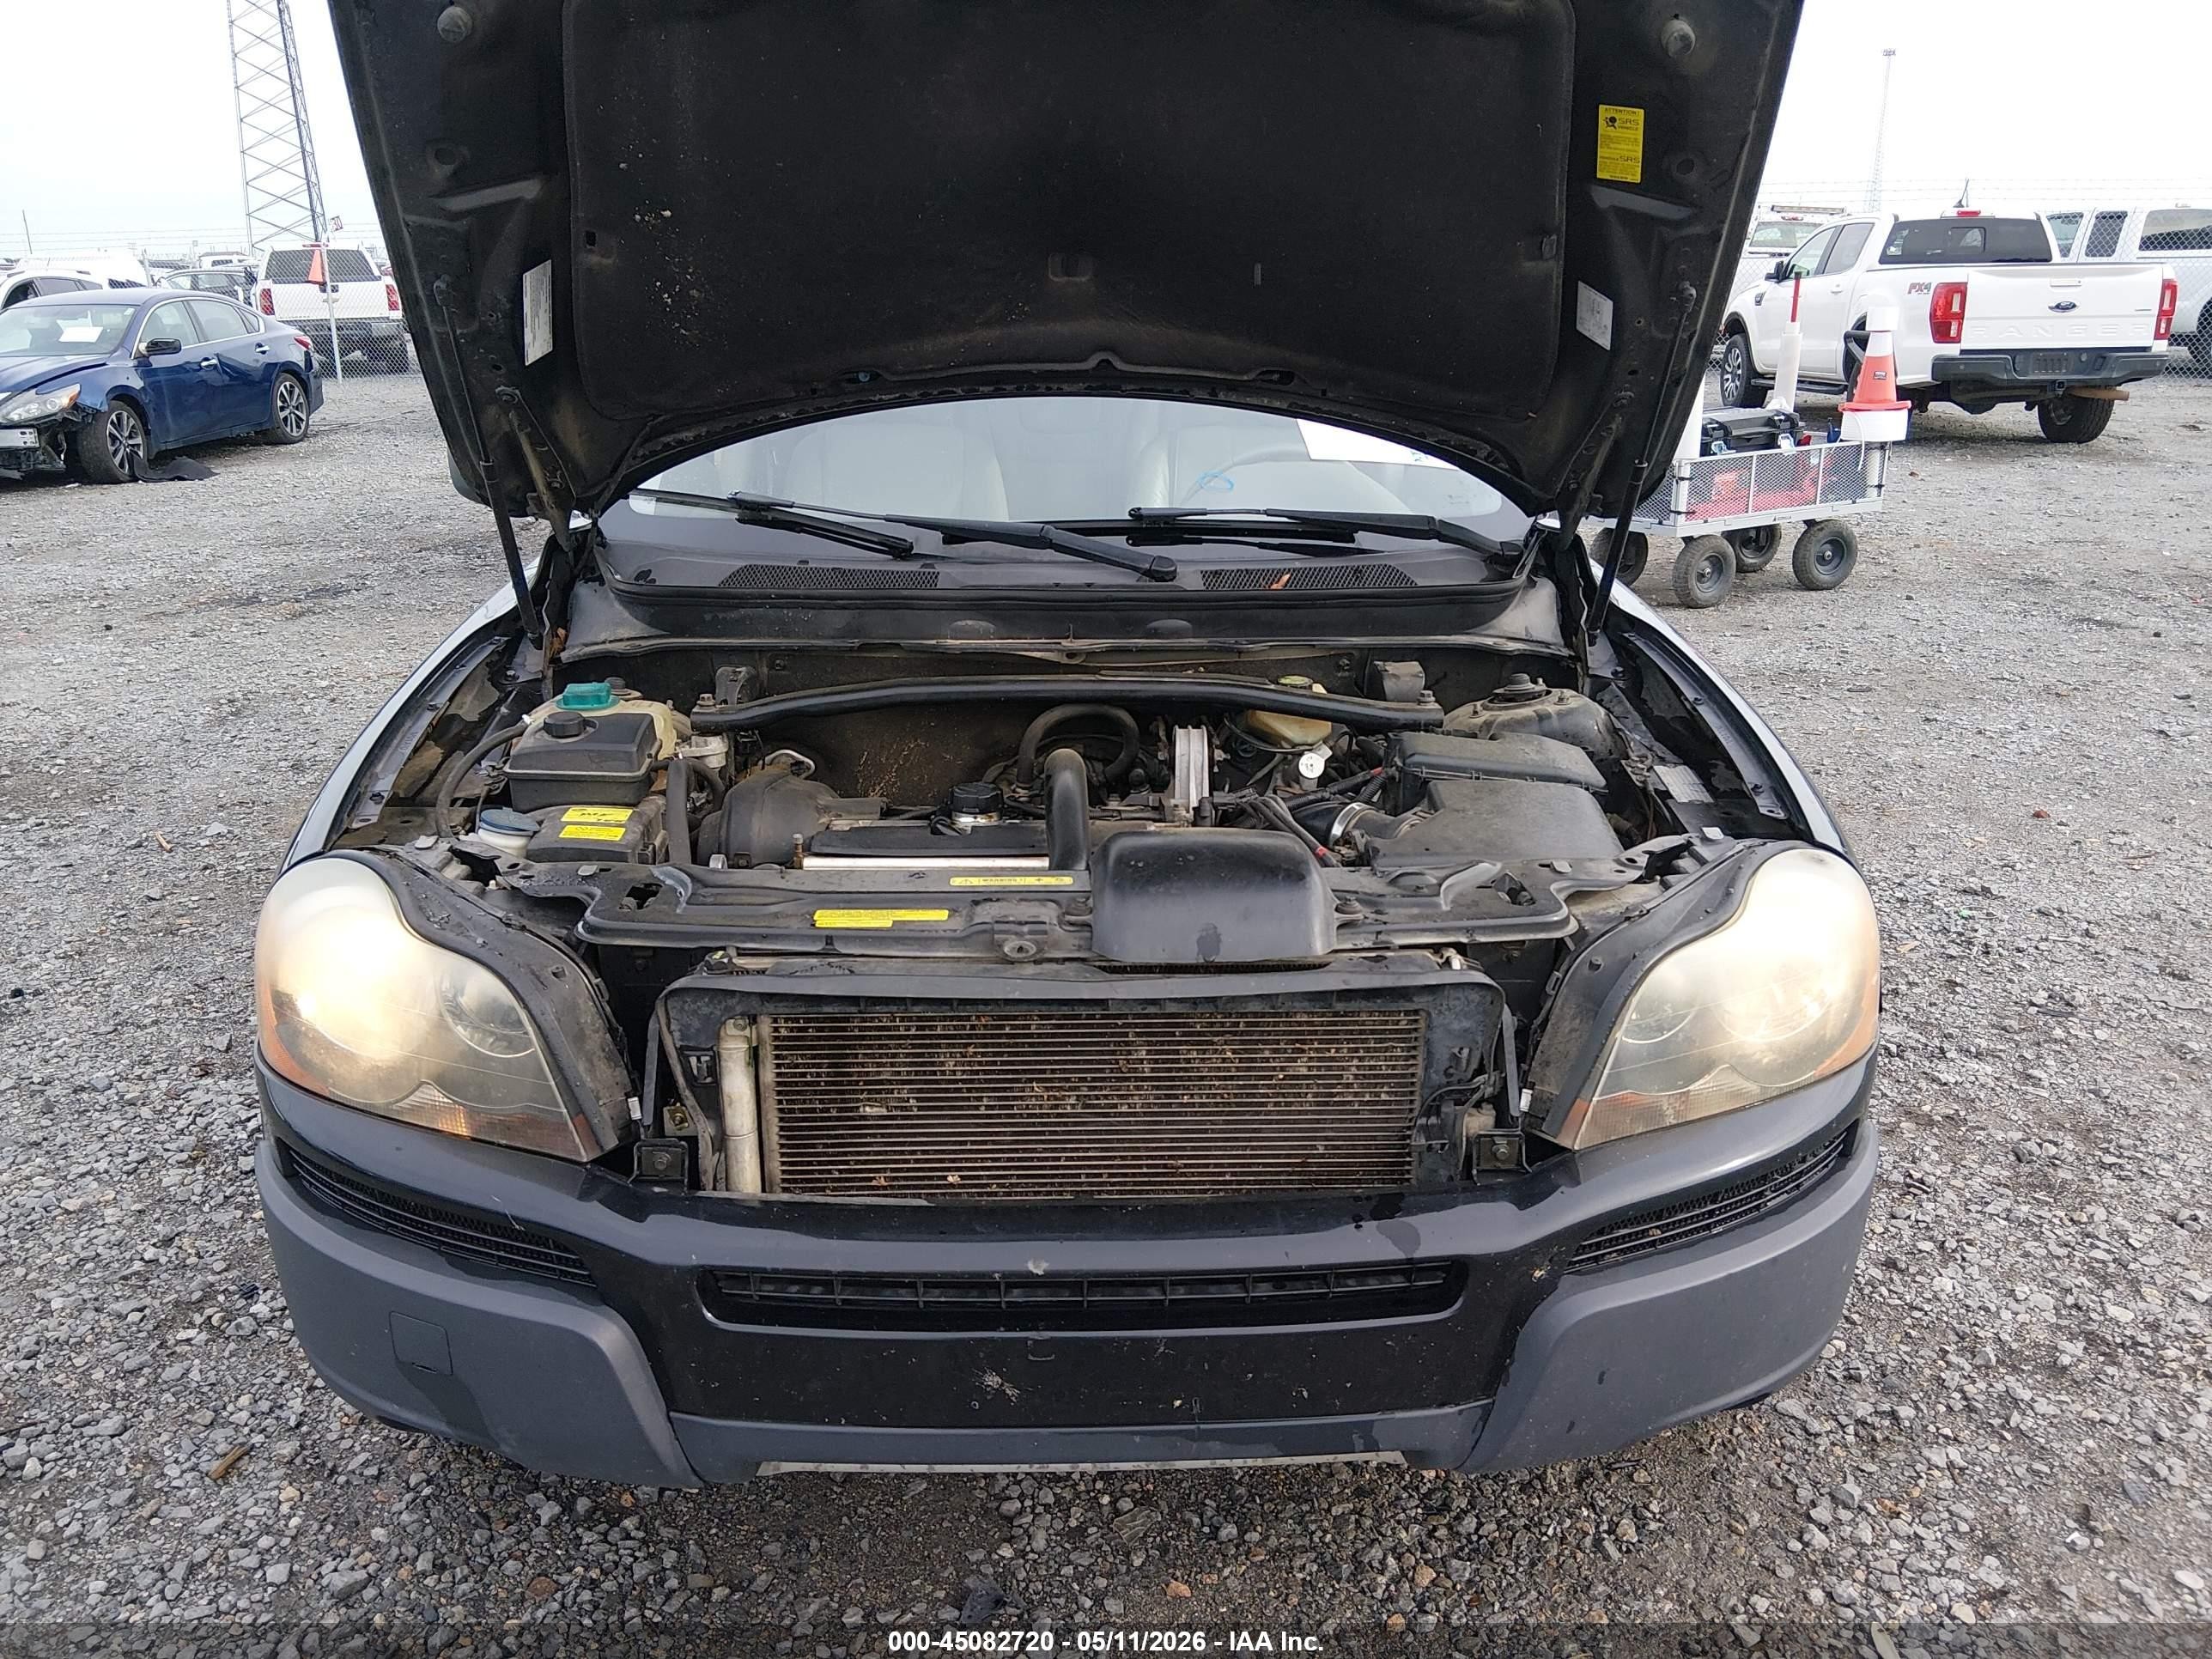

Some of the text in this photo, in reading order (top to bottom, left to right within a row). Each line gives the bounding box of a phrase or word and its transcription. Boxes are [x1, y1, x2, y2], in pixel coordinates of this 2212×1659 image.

[1618, 118, 1639, 126] SRS
[1907, 282, 1932, 295] FX4
[1969, 324, 2149, 338] RANGER
